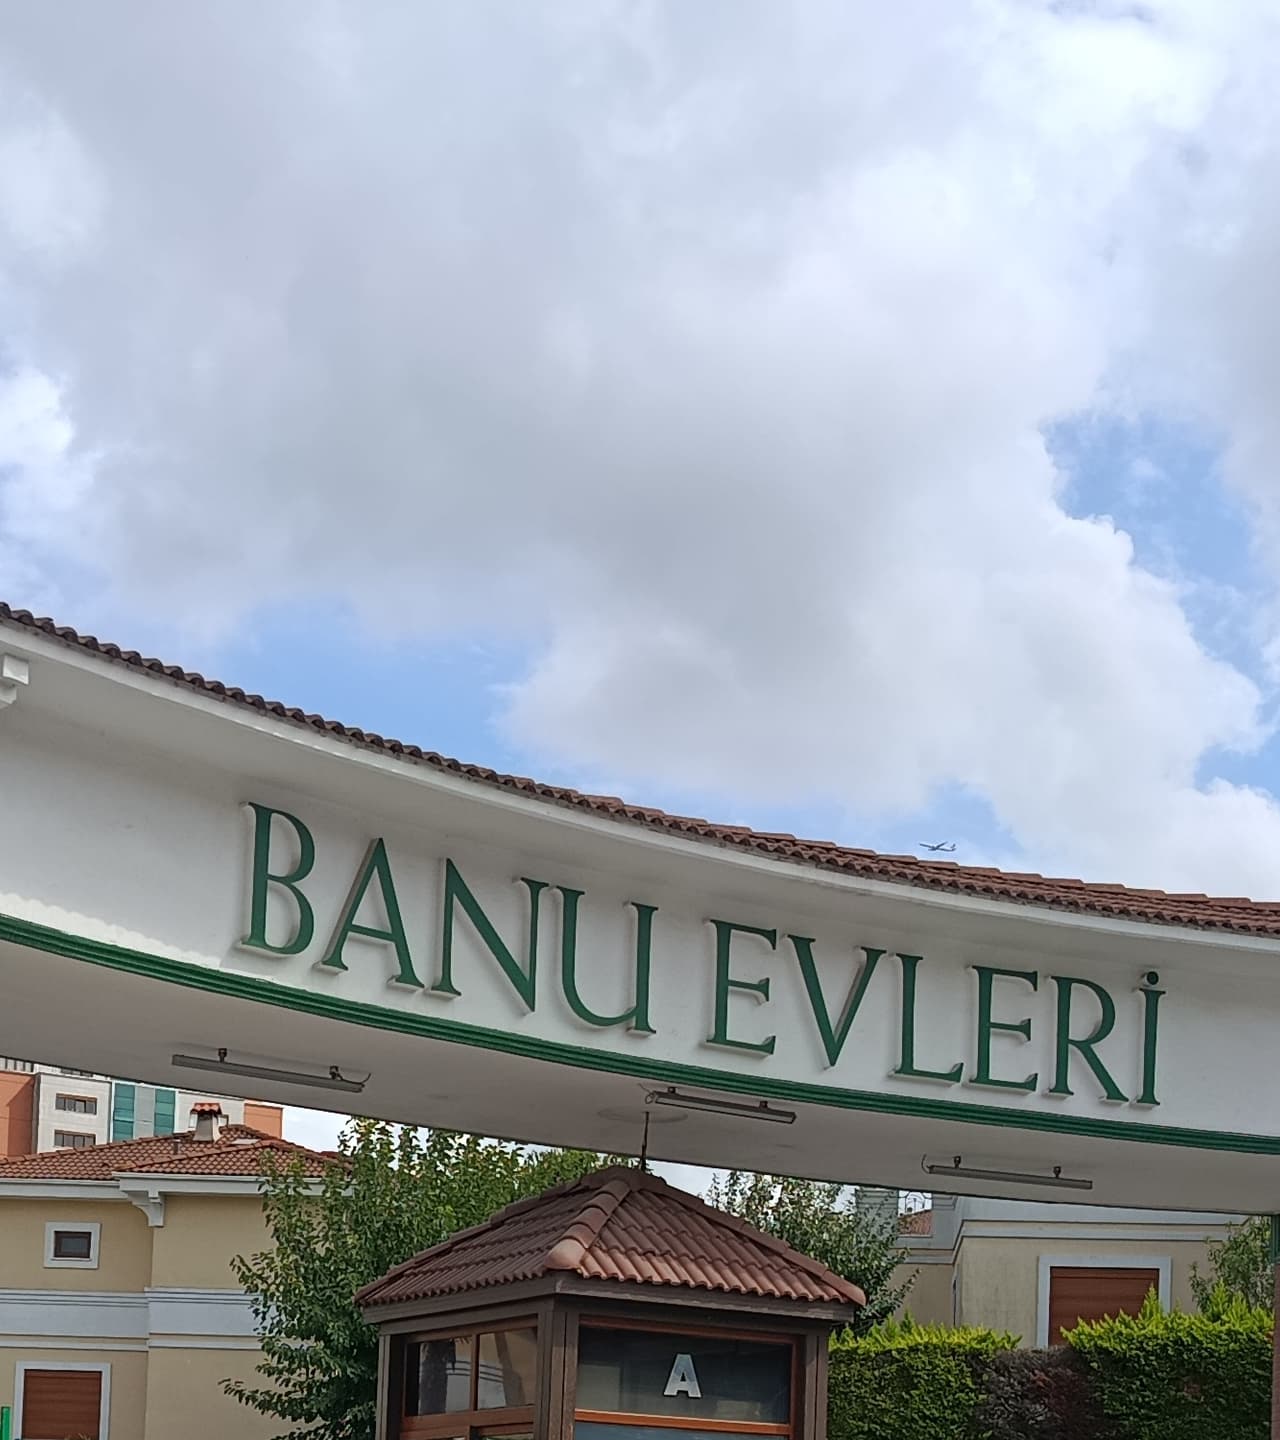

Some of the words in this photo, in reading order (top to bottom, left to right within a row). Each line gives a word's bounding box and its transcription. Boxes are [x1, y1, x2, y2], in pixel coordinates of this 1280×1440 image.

[240, 801, 658, 1036] BANU
[706, 918, 1166, 1107] EVLERİ
[663, 1353, 702, 1398] A
